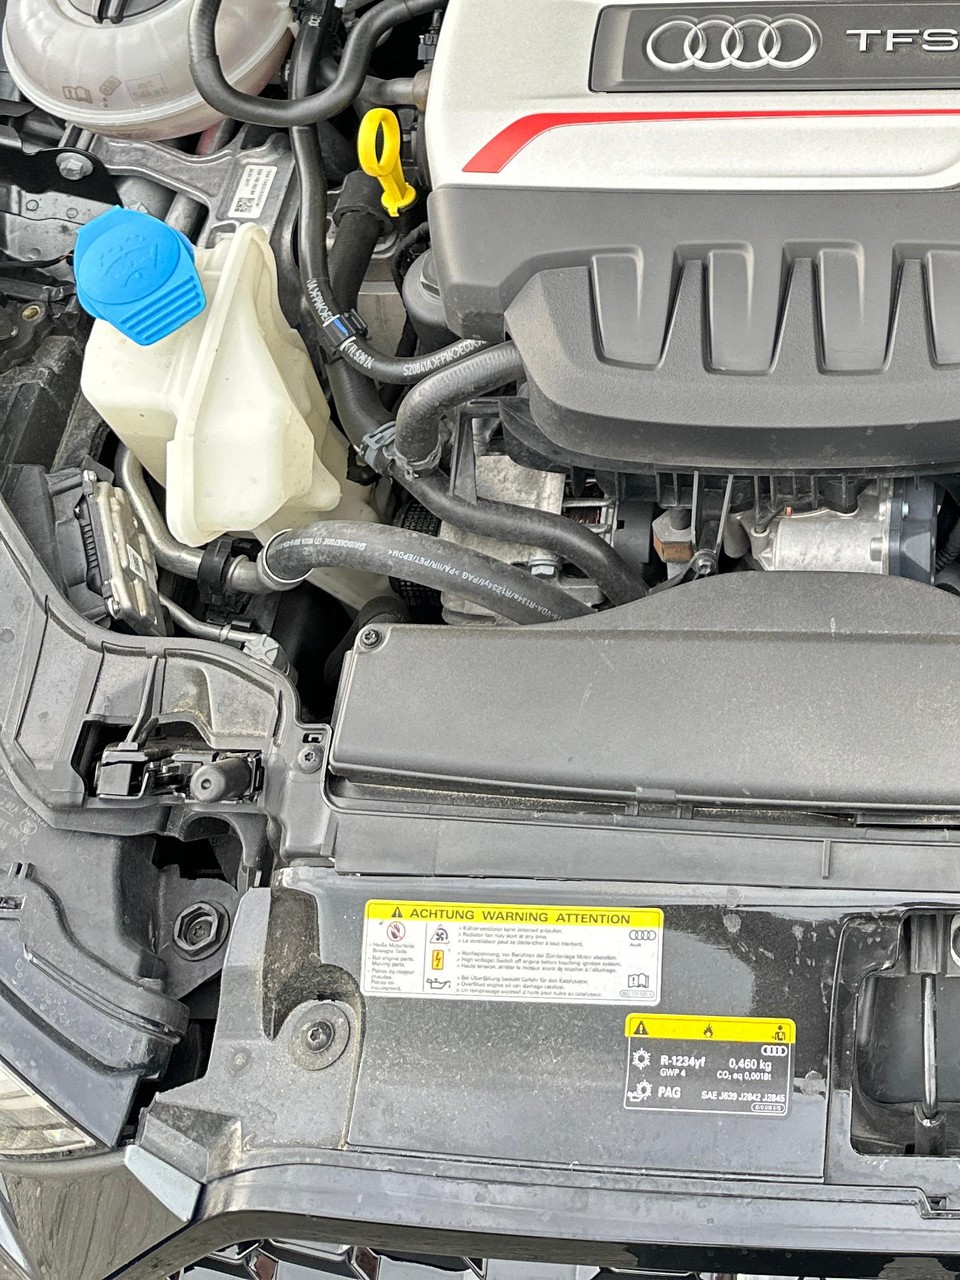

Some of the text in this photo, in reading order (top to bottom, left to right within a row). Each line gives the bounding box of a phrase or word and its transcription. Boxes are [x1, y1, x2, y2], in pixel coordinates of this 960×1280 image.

[410, 908, 631, 925] ACHTUNG WARNING ATTENTION
[660, 1054, 772, 1072] R-1234yf 0,460 kg
[660, 1067, 680, 1077] GWP
[680, 1069, 687, 1077] 4
[732, 1073, 743, 1081] eq
[657, 1085, 786, 1103] PAG SAE J639 J2842 J2845
